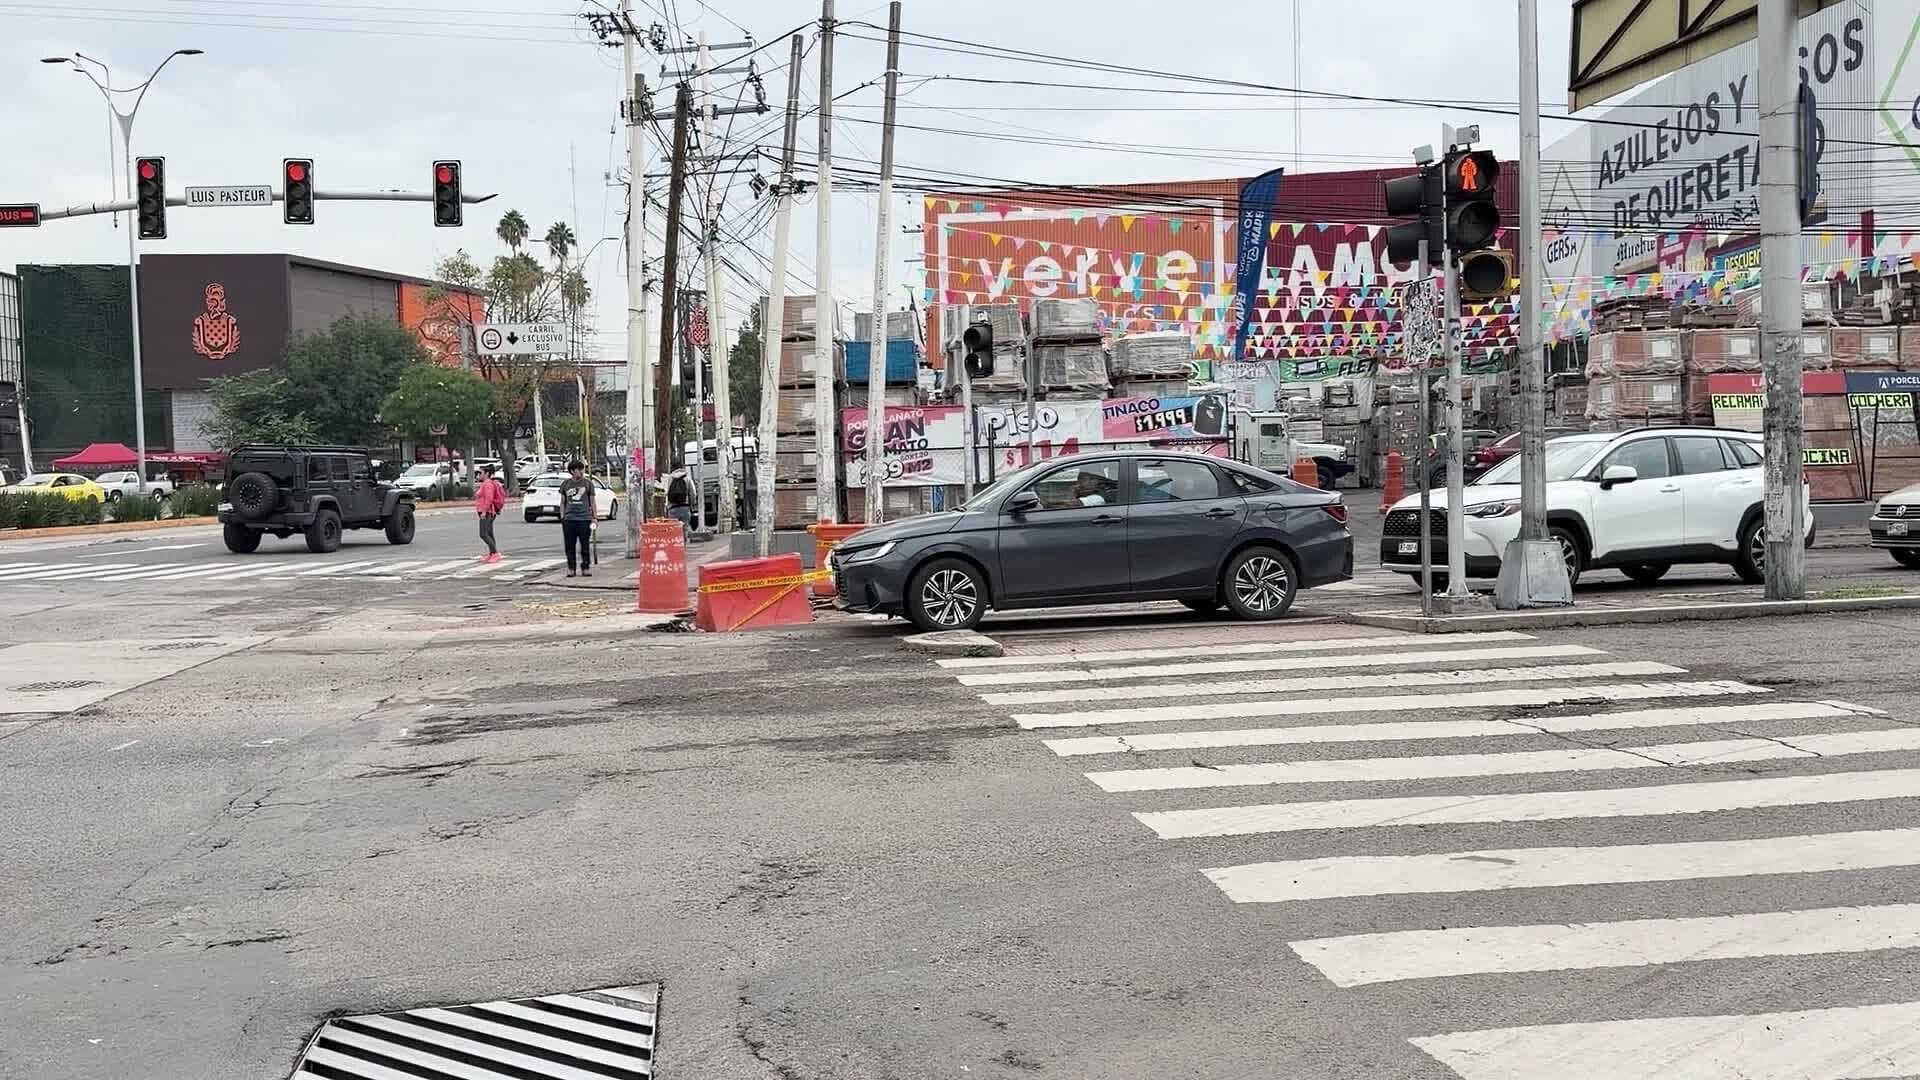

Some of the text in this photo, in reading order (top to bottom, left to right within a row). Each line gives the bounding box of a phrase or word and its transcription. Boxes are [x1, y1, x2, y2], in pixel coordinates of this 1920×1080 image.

[1598, 91, 1721, 190] AZULEJOS
[1728, 74, 1748, 124] Y
[191, 190, 266, 203] LUIS PASTEUR
[1614, 192, 1641, 239] DE
[1724, 249, 1761, 272] DESCUEN
[978, 249, 1199, 297] verve
[522, 334, 563, 343] EXCLUSIVO
[528, 325, 555, 333] CARRIL
[535, 343, 550, 351] BUS
[1103, 398, 1160, 420] TINACO
[1714, 394, 1764, 409] RECAMA
[1849, 394, 1912, 408] COCHERA
[848, 408, 924, 431] PORLANATO
[848, 417, 926, 451] GAN
[851, 438, 929, 464] FOMATO
